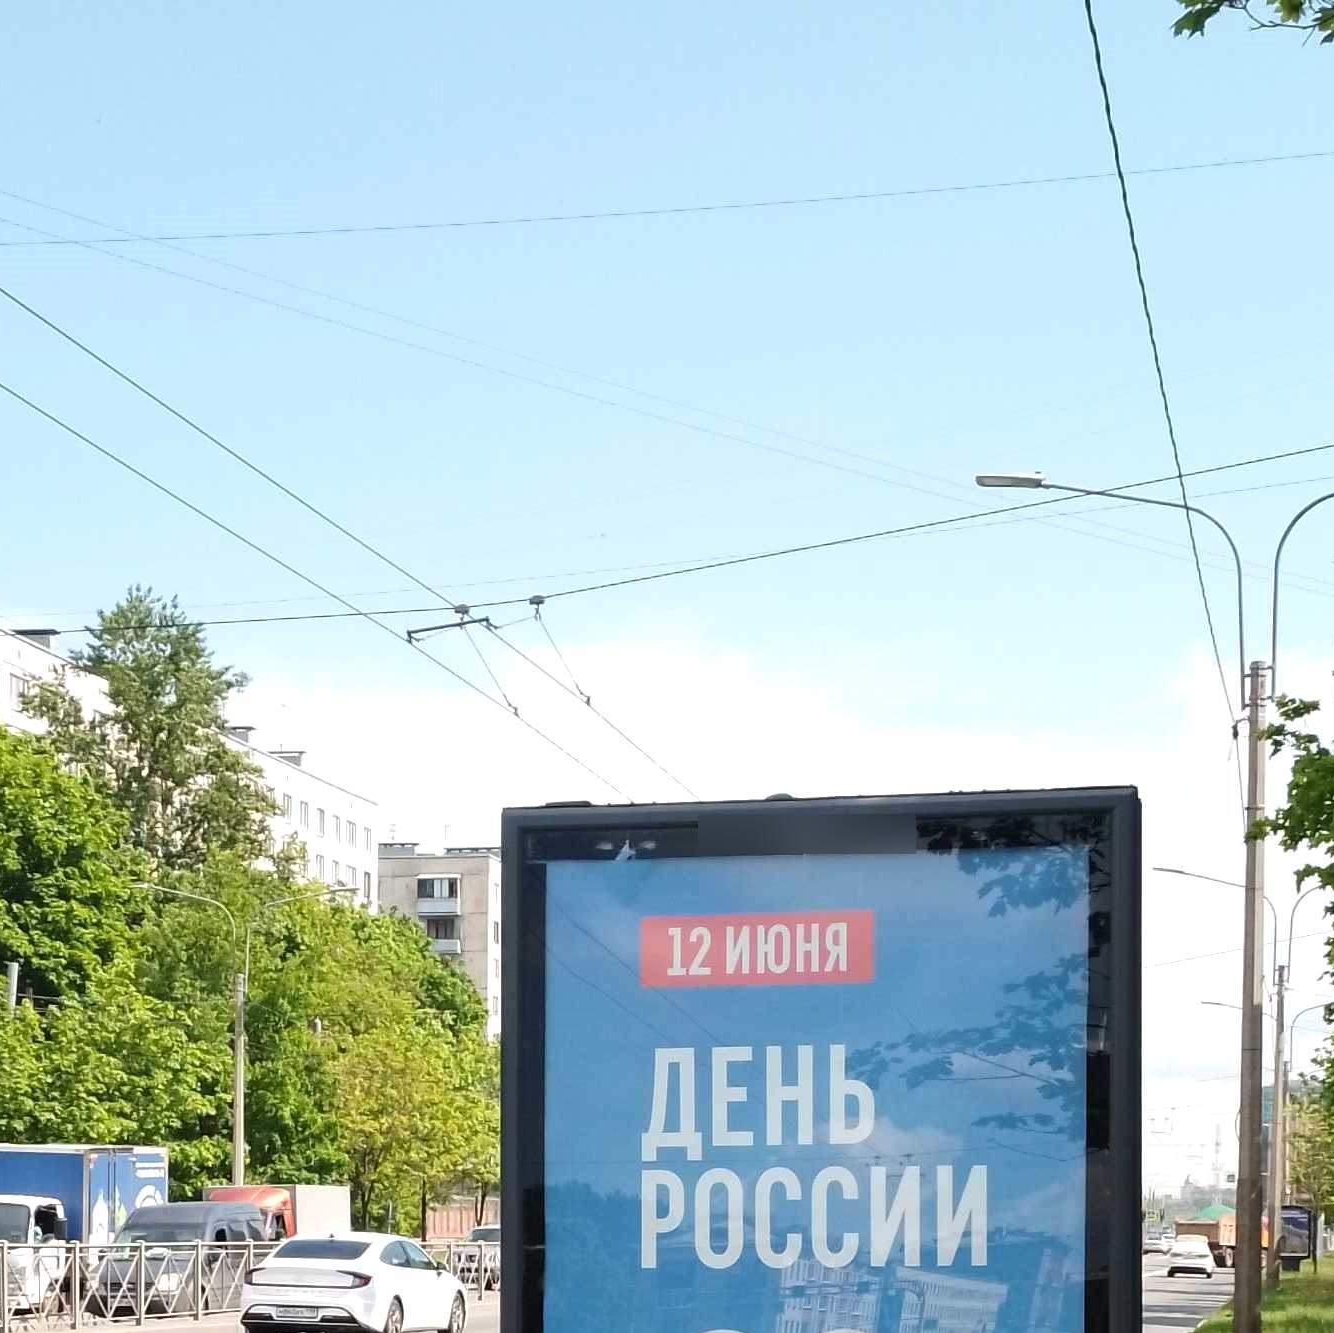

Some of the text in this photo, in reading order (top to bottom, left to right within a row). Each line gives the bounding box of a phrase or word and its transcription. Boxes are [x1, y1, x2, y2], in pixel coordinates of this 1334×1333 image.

[667, 922, 848, 976] 12 ИЮНЯ
[641, 1044, 876, 1162] ДЕНЬ
[641, 1165, 988, 1270] РОССИИ
